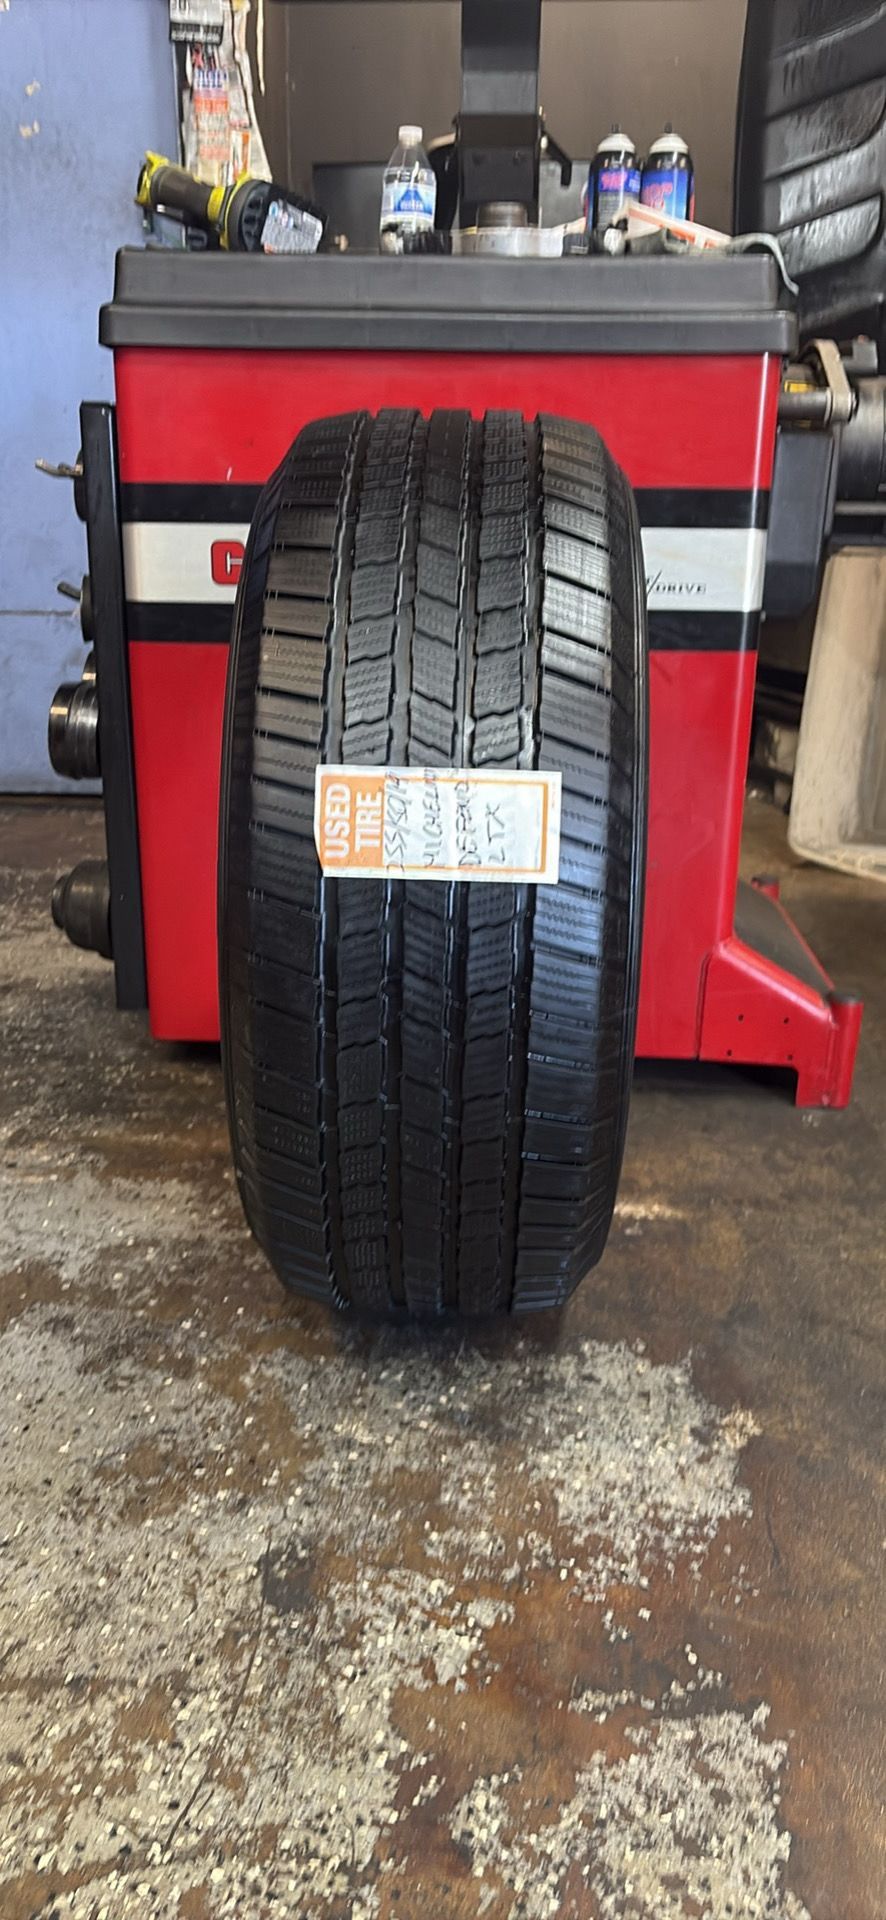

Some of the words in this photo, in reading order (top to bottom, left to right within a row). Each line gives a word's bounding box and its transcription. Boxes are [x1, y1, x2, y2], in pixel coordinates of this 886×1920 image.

[324, 783, 351, 859] USED
[354, 791, 383, 853] TIRE
[484, 802, 506, 864] LTX
